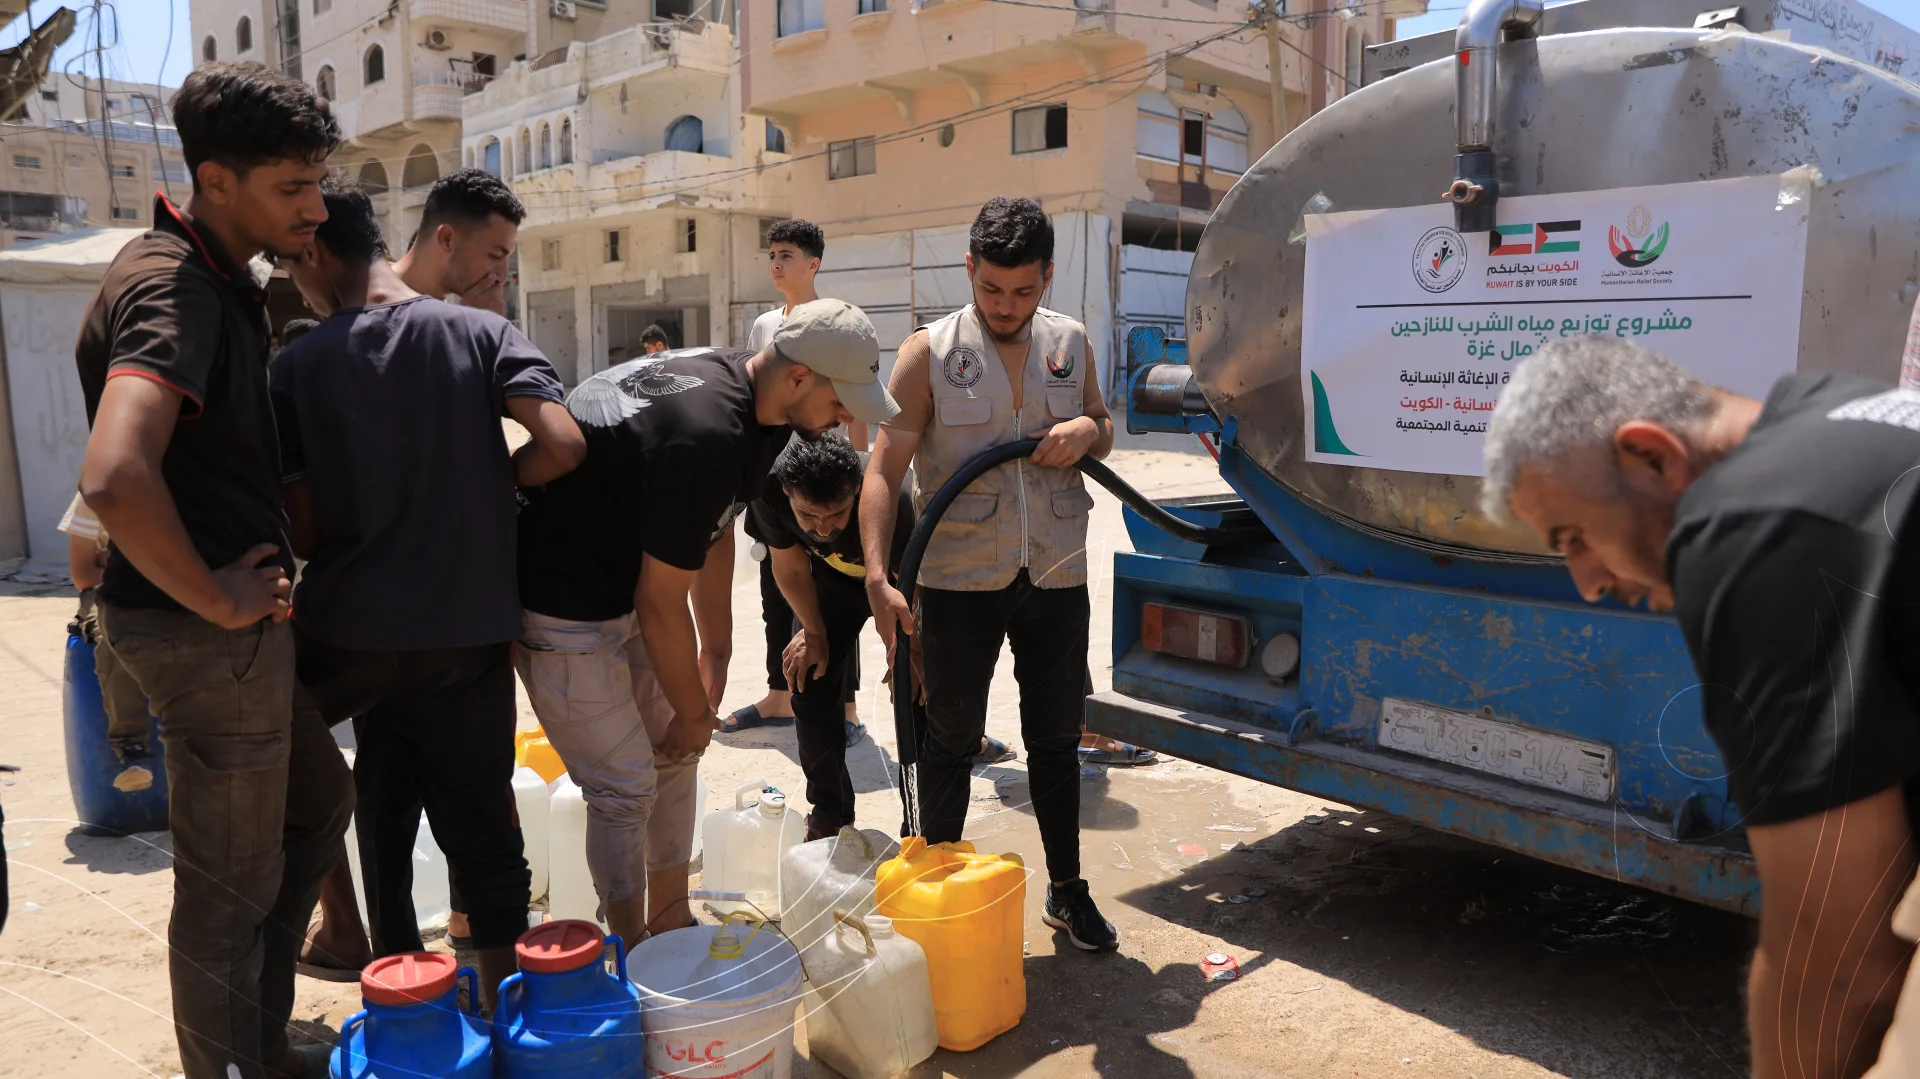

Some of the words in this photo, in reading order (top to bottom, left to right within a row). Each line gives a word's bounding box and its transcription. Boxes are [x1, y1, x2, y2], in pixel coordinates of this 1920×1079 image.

[1487, 263, 1535, 276] بجانبكم
[1537, 260, 1579, 273] الكويت
[1652, 268, 1673, 277] جمعية
[1485, 280, 1515, 289] KUWAIT
[1516, 280, 1523, 288] IS
[1525, 279, 1535, 288] BY
[1536, 278, 1558, 287] YOUR
[1559, 277, 1578, 287] SIDE
[1391, 316, 1454, 337] للنازحين
[1457, 311, 1513, 337] الشرب
[1517, 315, 1555, 337] مياه
[1559, 313, 1612, 338] توزيع
[1615, 308, 1692, 337] مشروع
[1467, 340, 1495, 361] غزة
[1400, 369, 1455, 389] الإنسانية
[1457, 370, 1498, 389] الإغاثة
[1400, 396, 1443, 412] الكويت
[1395, 417, 1451, 434] المجتمعية
[1453, 420, 1488, 436] تنمية
[665, 1038, 727, 1063] GLC
